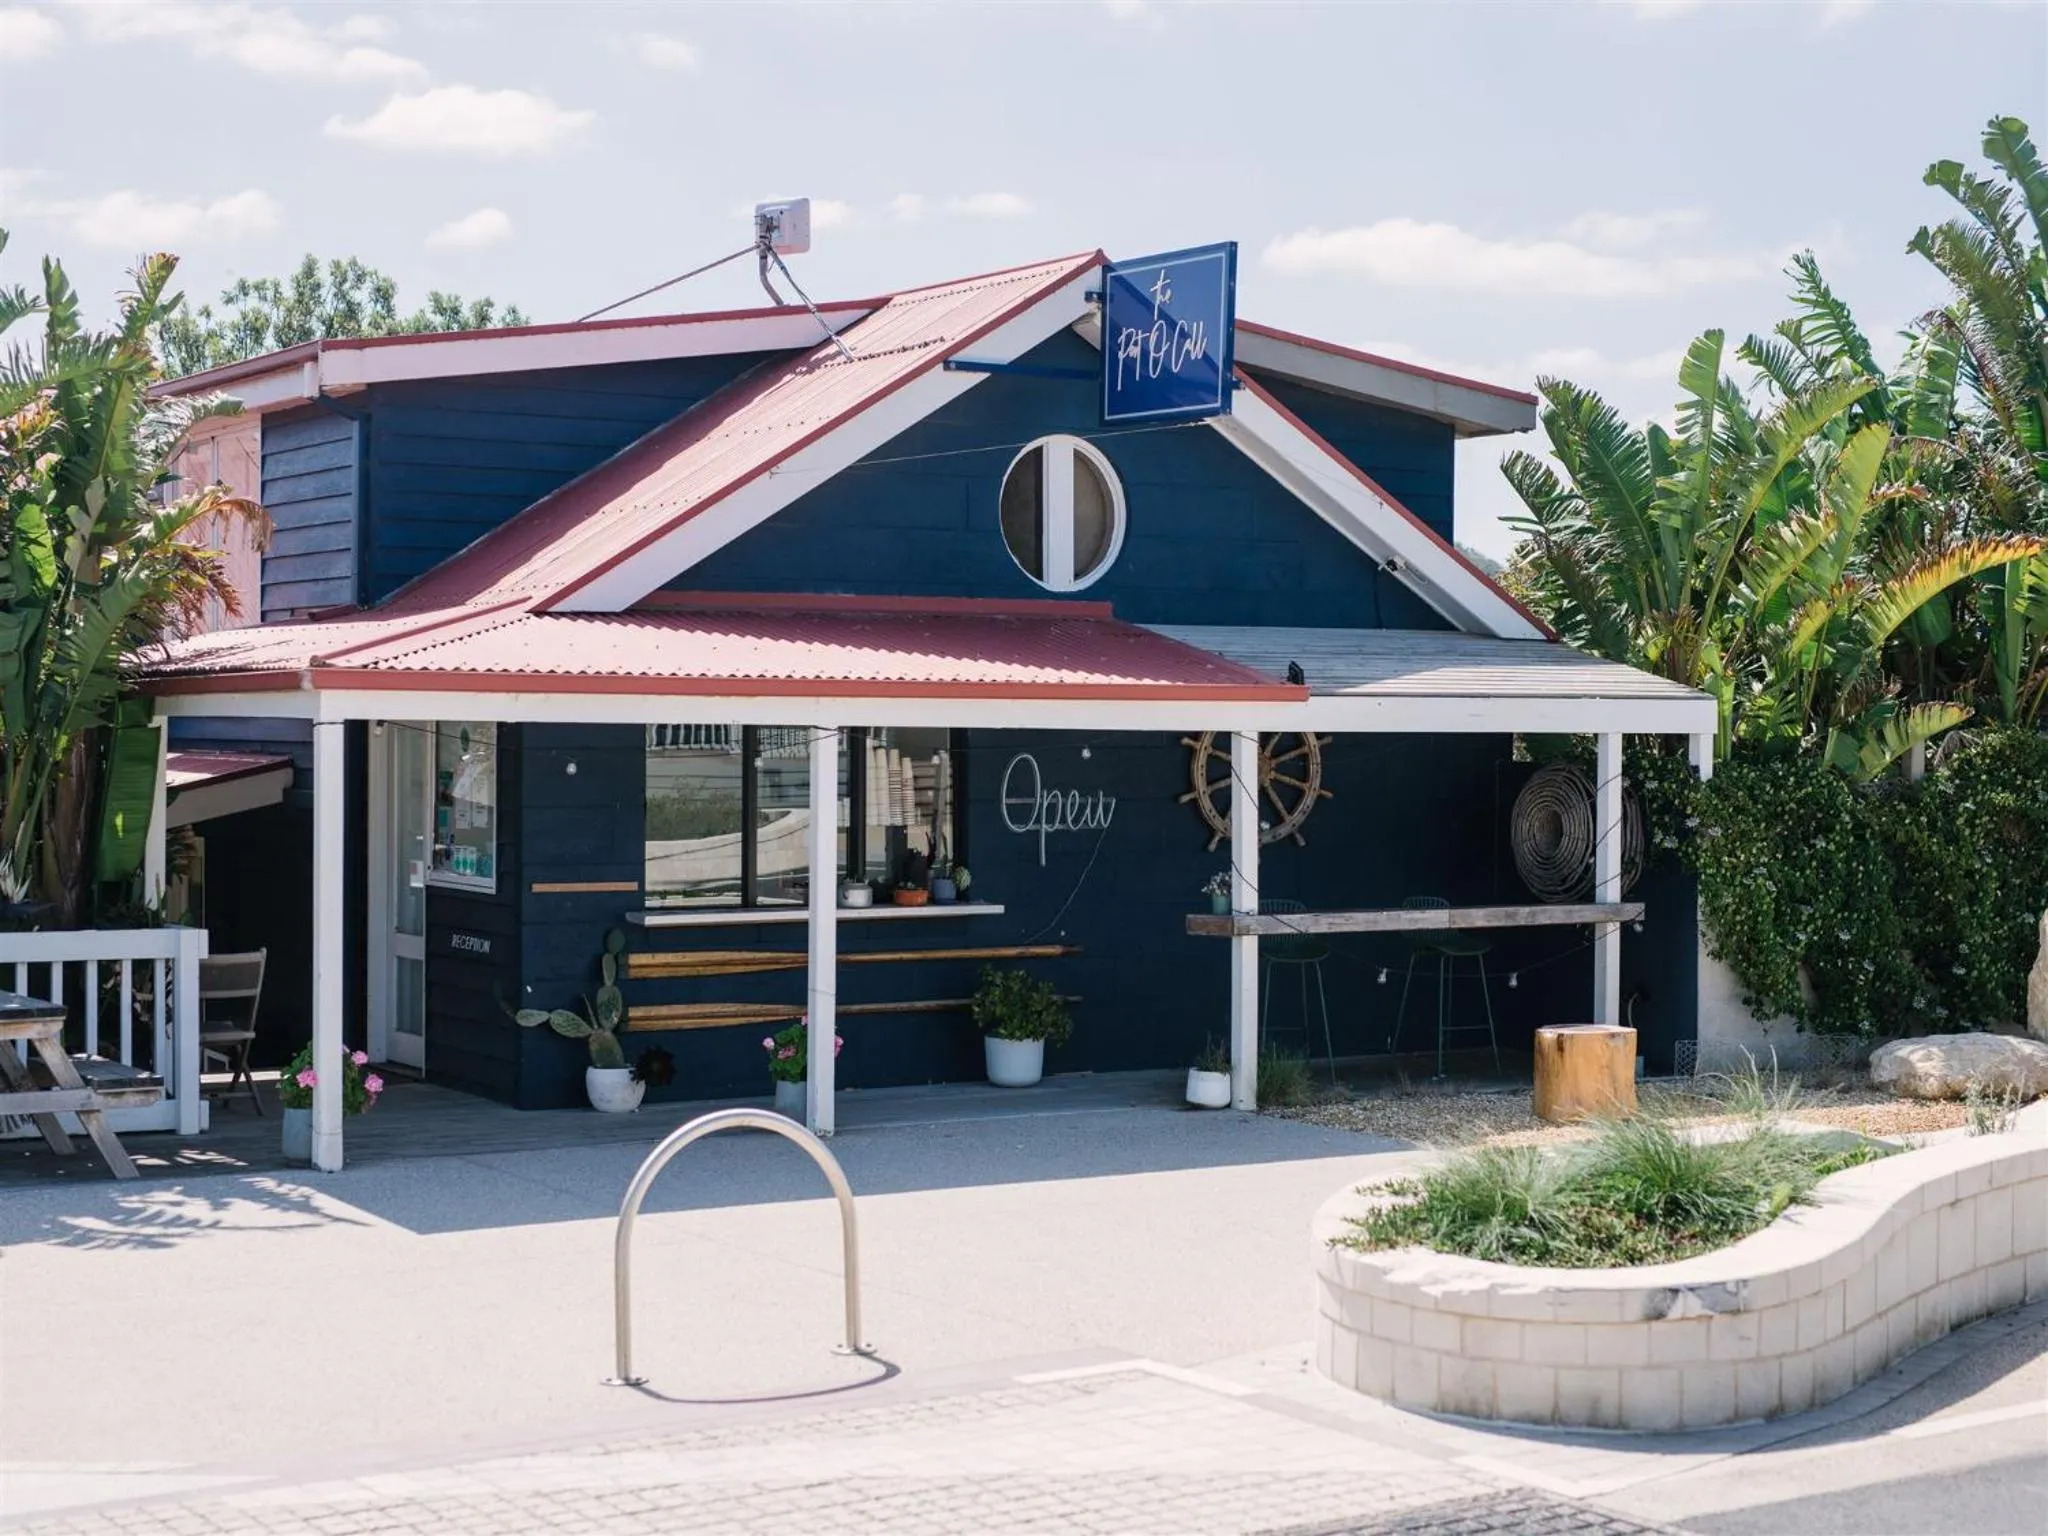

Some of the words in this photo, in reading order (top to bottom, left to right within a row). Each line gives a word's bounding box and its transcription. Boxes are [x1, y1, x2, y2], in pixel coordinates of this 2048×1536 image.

[1172, 320, 1208, 373] Call
[1002, 754, 1116, 866] Open
[451, 933, 491, 954] RECEPTION
